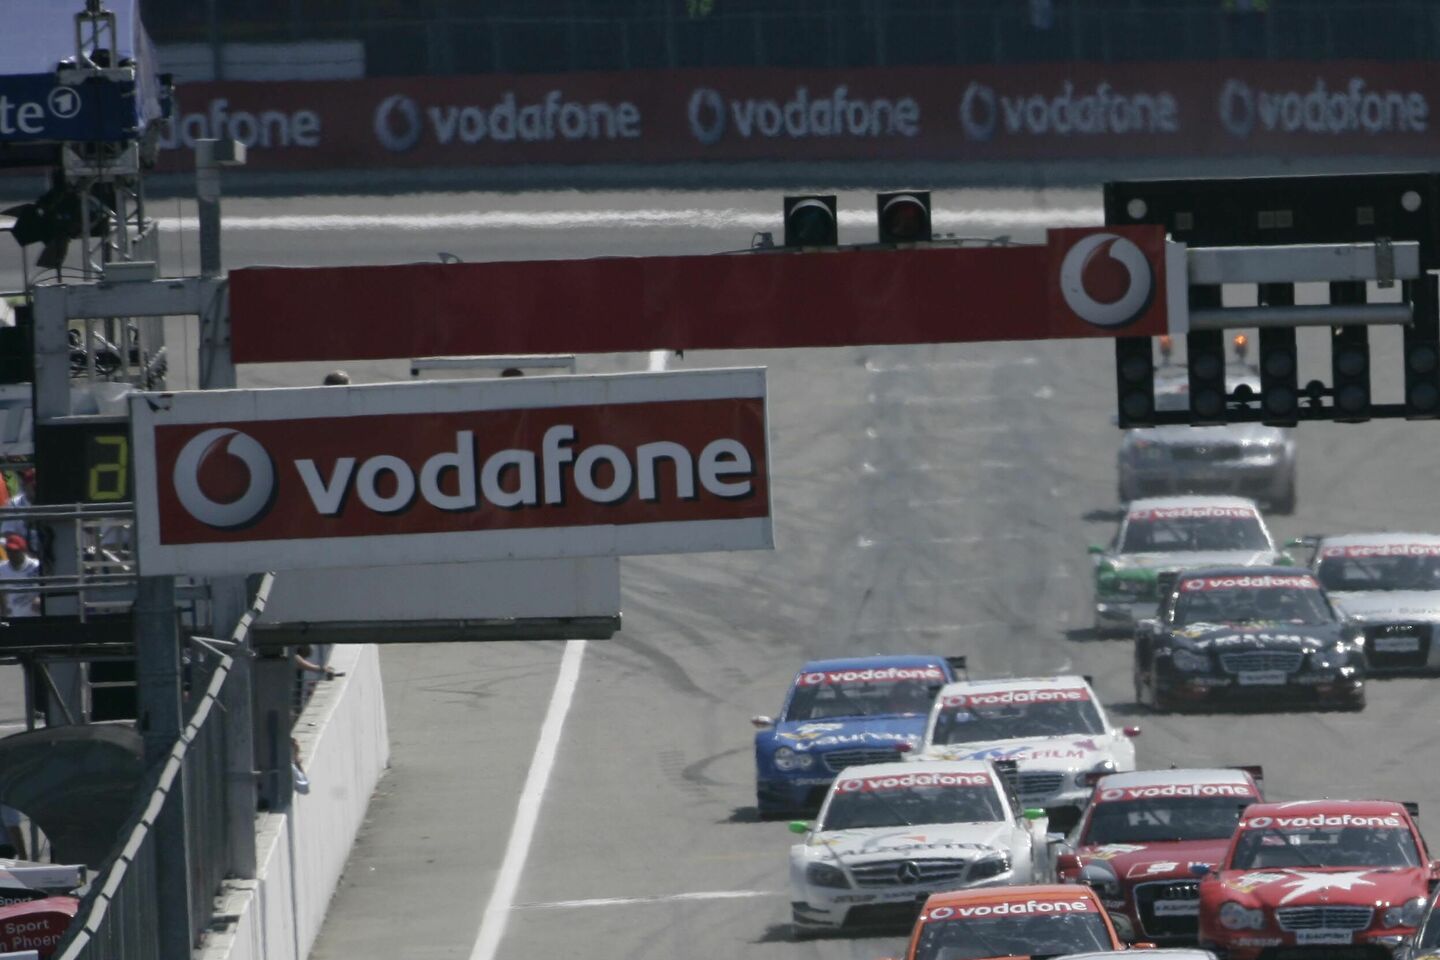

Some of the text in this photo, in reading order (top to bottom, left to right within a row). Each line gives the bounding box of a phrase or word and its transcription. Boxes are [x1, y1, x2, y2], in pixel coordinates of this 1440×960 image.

[731, 84, 920, 139] vodafone
[1003, 78, 1180, 133] vodafone
[1259, 77, 1429, 133] vodafone
[157, 98, 321, 149] dafone
[429, 90, 641, 144] vodafone
[295, 424, 753, 516] vodafone
[1156, 507, 1251, 518] vodafone
[1210, 575, 1313, 588] vodafone
[830, 668, 943, 682] vodafone
[971, 690, 1082, 704] vodafone
[868, 774, 988, 788] vodafone
[1129, 785, 1250, 797] vodafone
[1277, 815, 1399, 827] vodafone
[959, 900, 1088, 916] vodafone
[5, 919, 50, 936] Sport
[12, 930, 62, 950] Phoen
